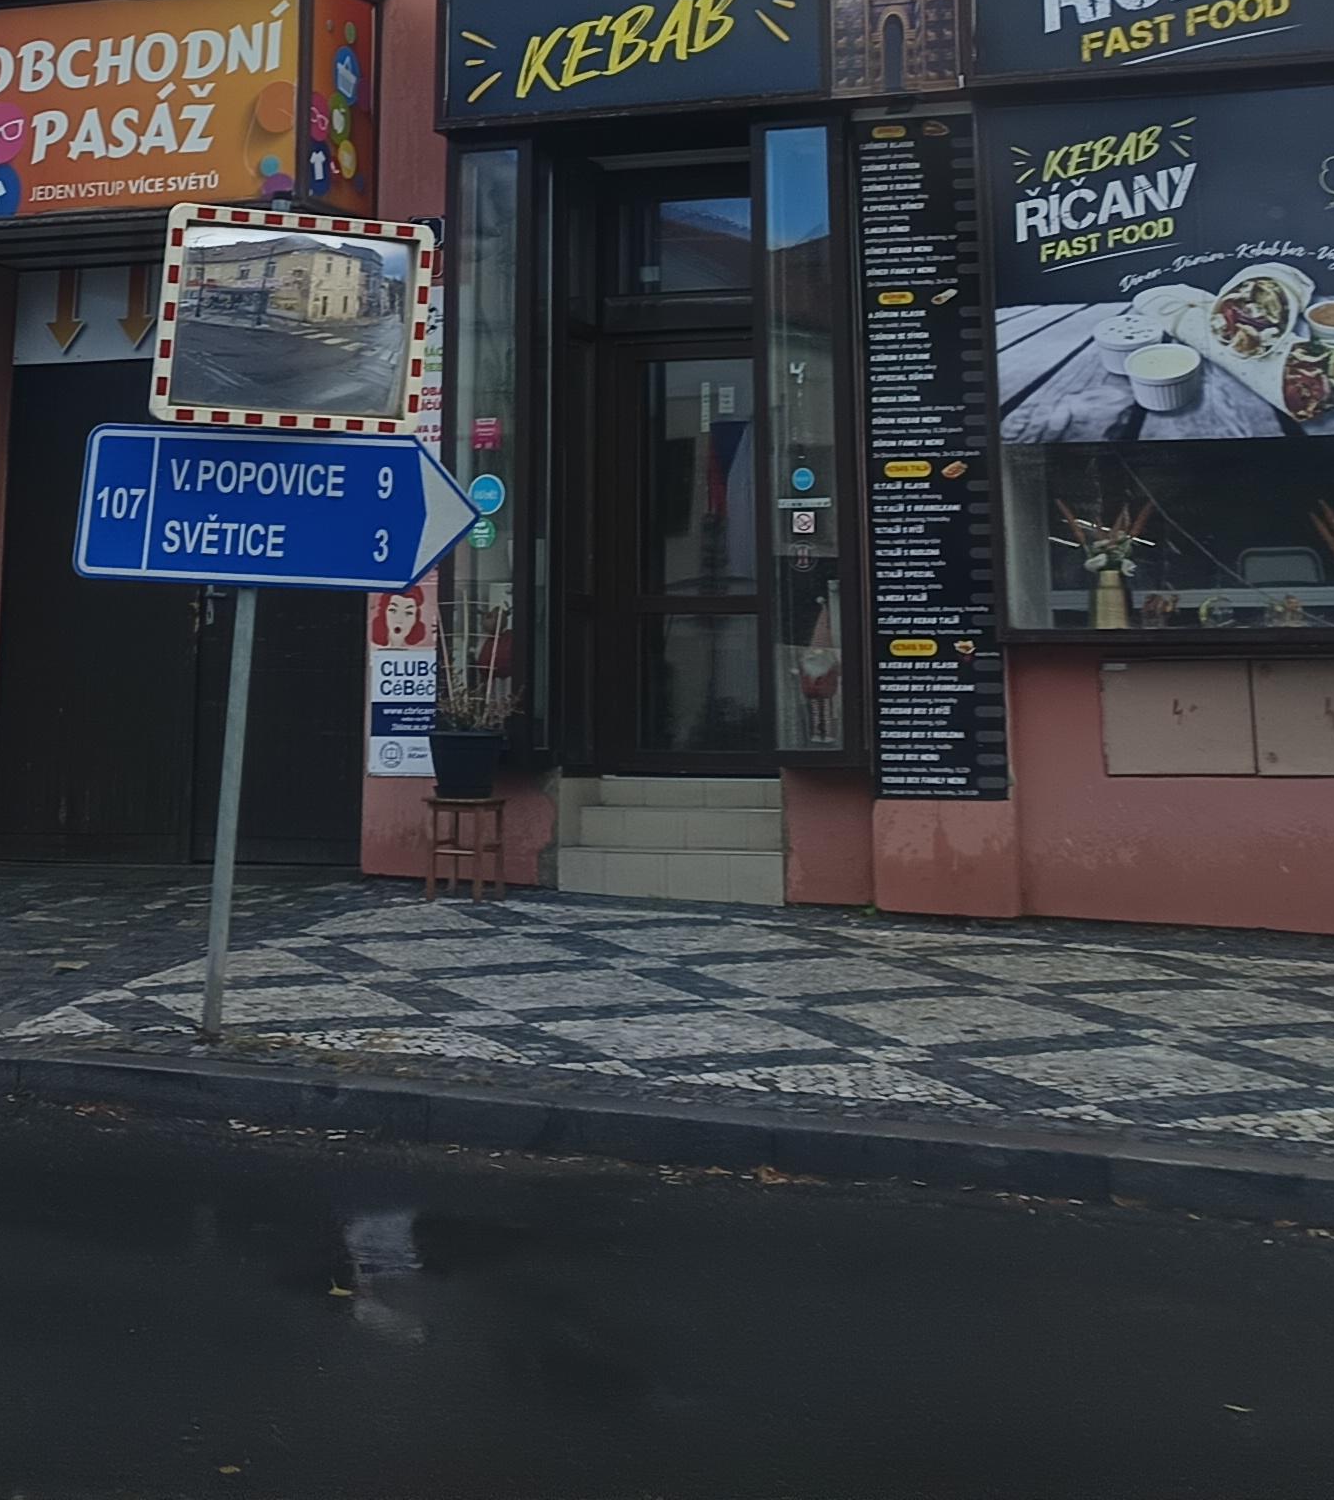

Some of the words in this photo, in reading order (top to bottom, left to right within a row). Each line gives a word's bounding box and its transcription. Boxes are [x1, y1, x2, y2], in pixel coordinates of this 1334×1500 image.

[1081, 13, 1175, 63] FAST
[30, 82, 215, 166] PASÁŽ
[1041, 125, 1163, 182] KEBAB
[29, 181, 76, 203] JEDEN
[77, 178, 125, 199] VSTUP
[127, 174, 165, 195] VÍCE
[167, 169, 219, 193] SVĚTŮ
[1016, 162, 1198, 243] ŘÍČANY
[1040, 232, 1102, 263] FAST
[1107, 216, 1174, 248] FOOD
[97, 486, 147, 520] 107
[377, 466, 394, 499] 9
[162, 513, 286, 558] SVĚTICE
[372, 529, 389, 563] 3
[381, 661, 428, 677] CLUB
